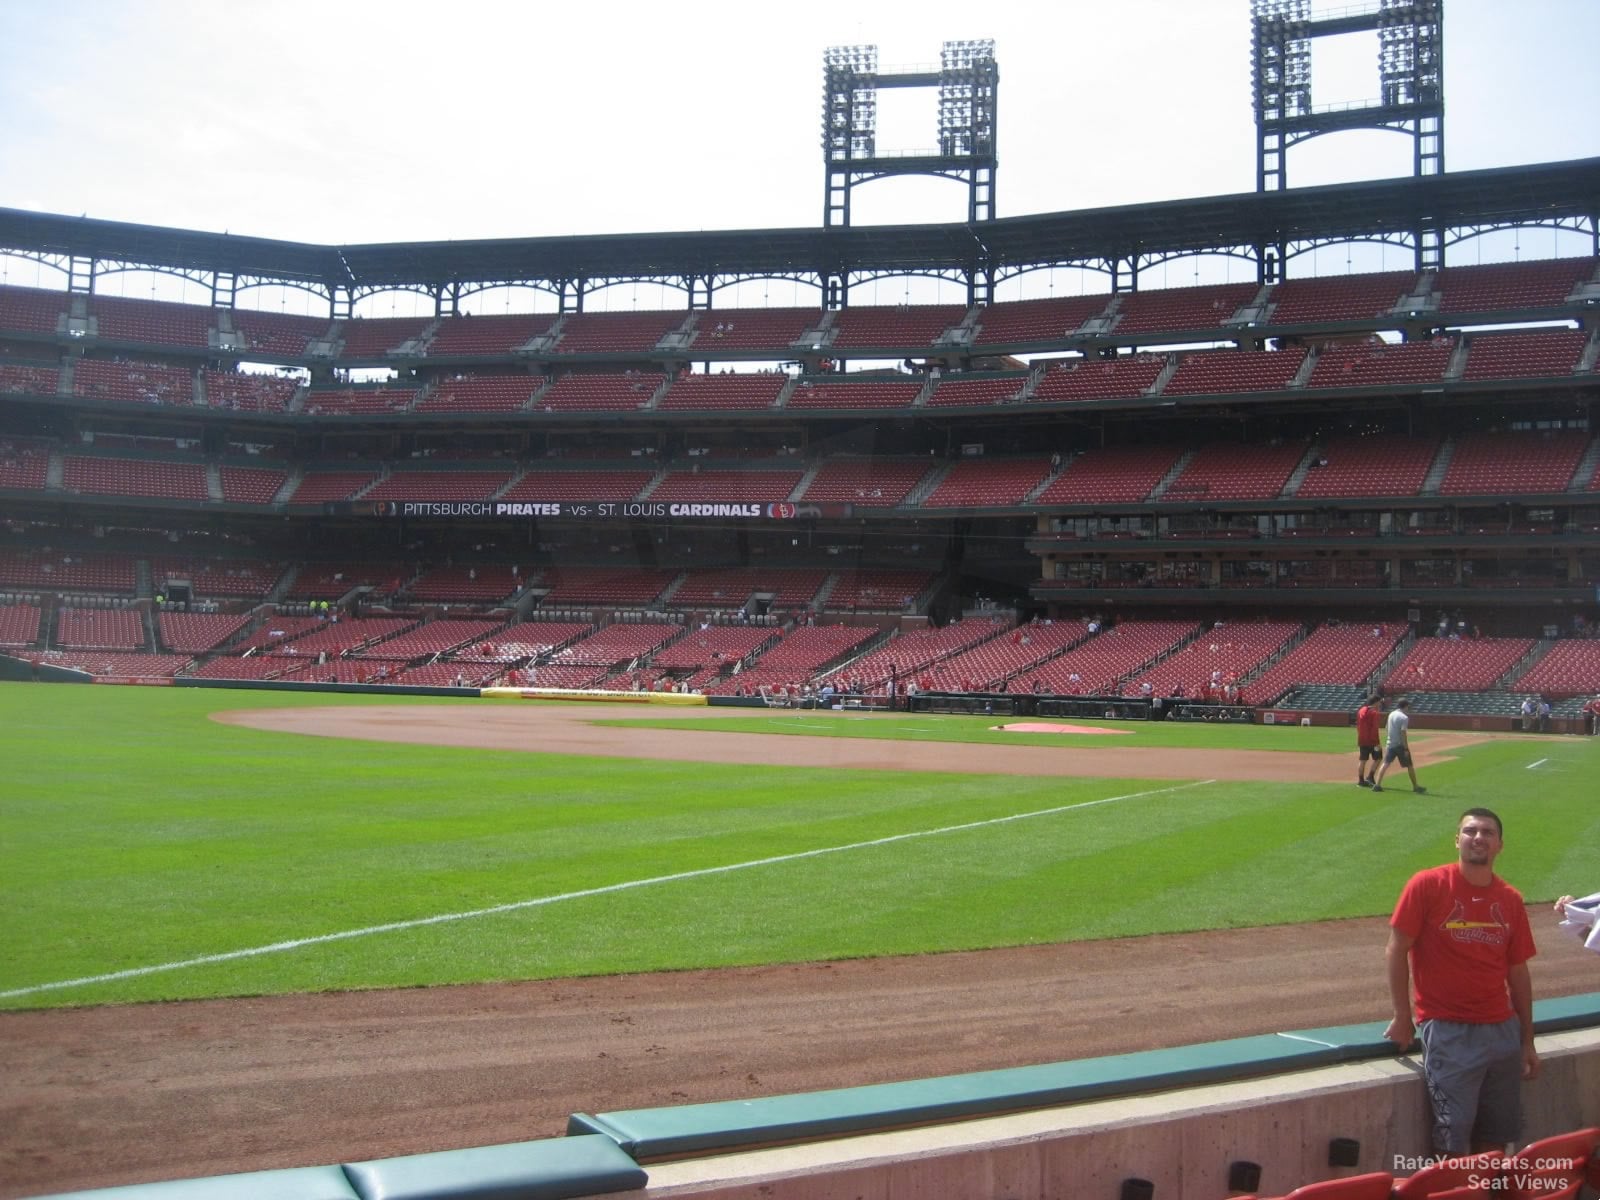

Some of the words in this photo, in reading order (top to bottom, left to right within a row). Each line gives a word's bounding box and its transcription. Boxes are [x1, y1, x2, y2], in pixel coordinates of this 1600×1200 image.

[404, 503, 492, 515] PITTSBURGH
[496, 503, 561, 515] PIRATES
[598, 503, 617, 516] ST.
[623, 503, 665, 516] LOUIS
[669, 504, 761, 517] CARDINALS
